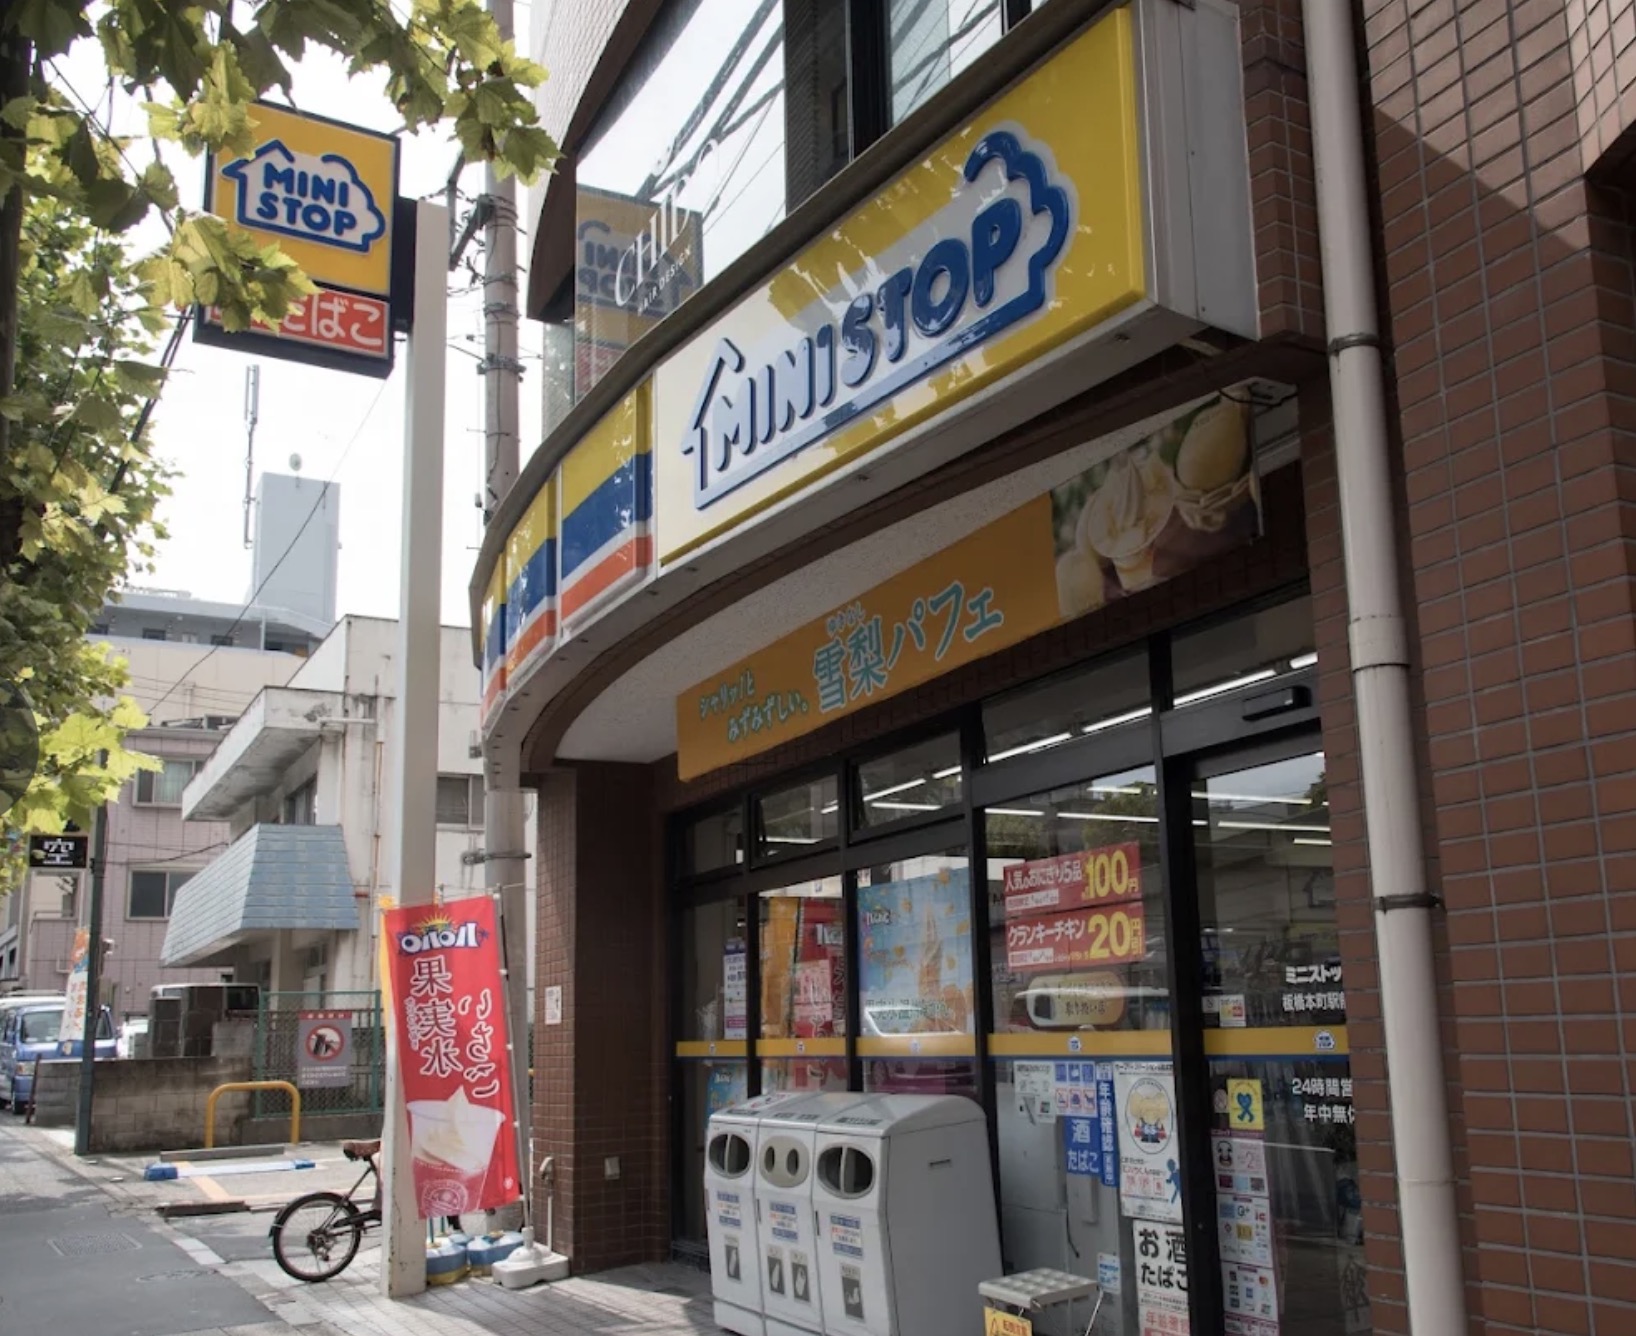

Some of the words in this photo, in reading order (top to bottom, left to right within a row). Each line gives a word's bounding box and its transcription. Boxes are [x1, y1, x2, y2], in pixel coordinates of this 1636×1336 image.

[264, 161, 350, 209] MINI
[256, 191, 358, 237] STOP
[812, 579, 1004, 714] 雪梨パフェ
[1071, 1119, 1091, 1144] 酒
[1066, 1149, 1100, 1174] たばこ
